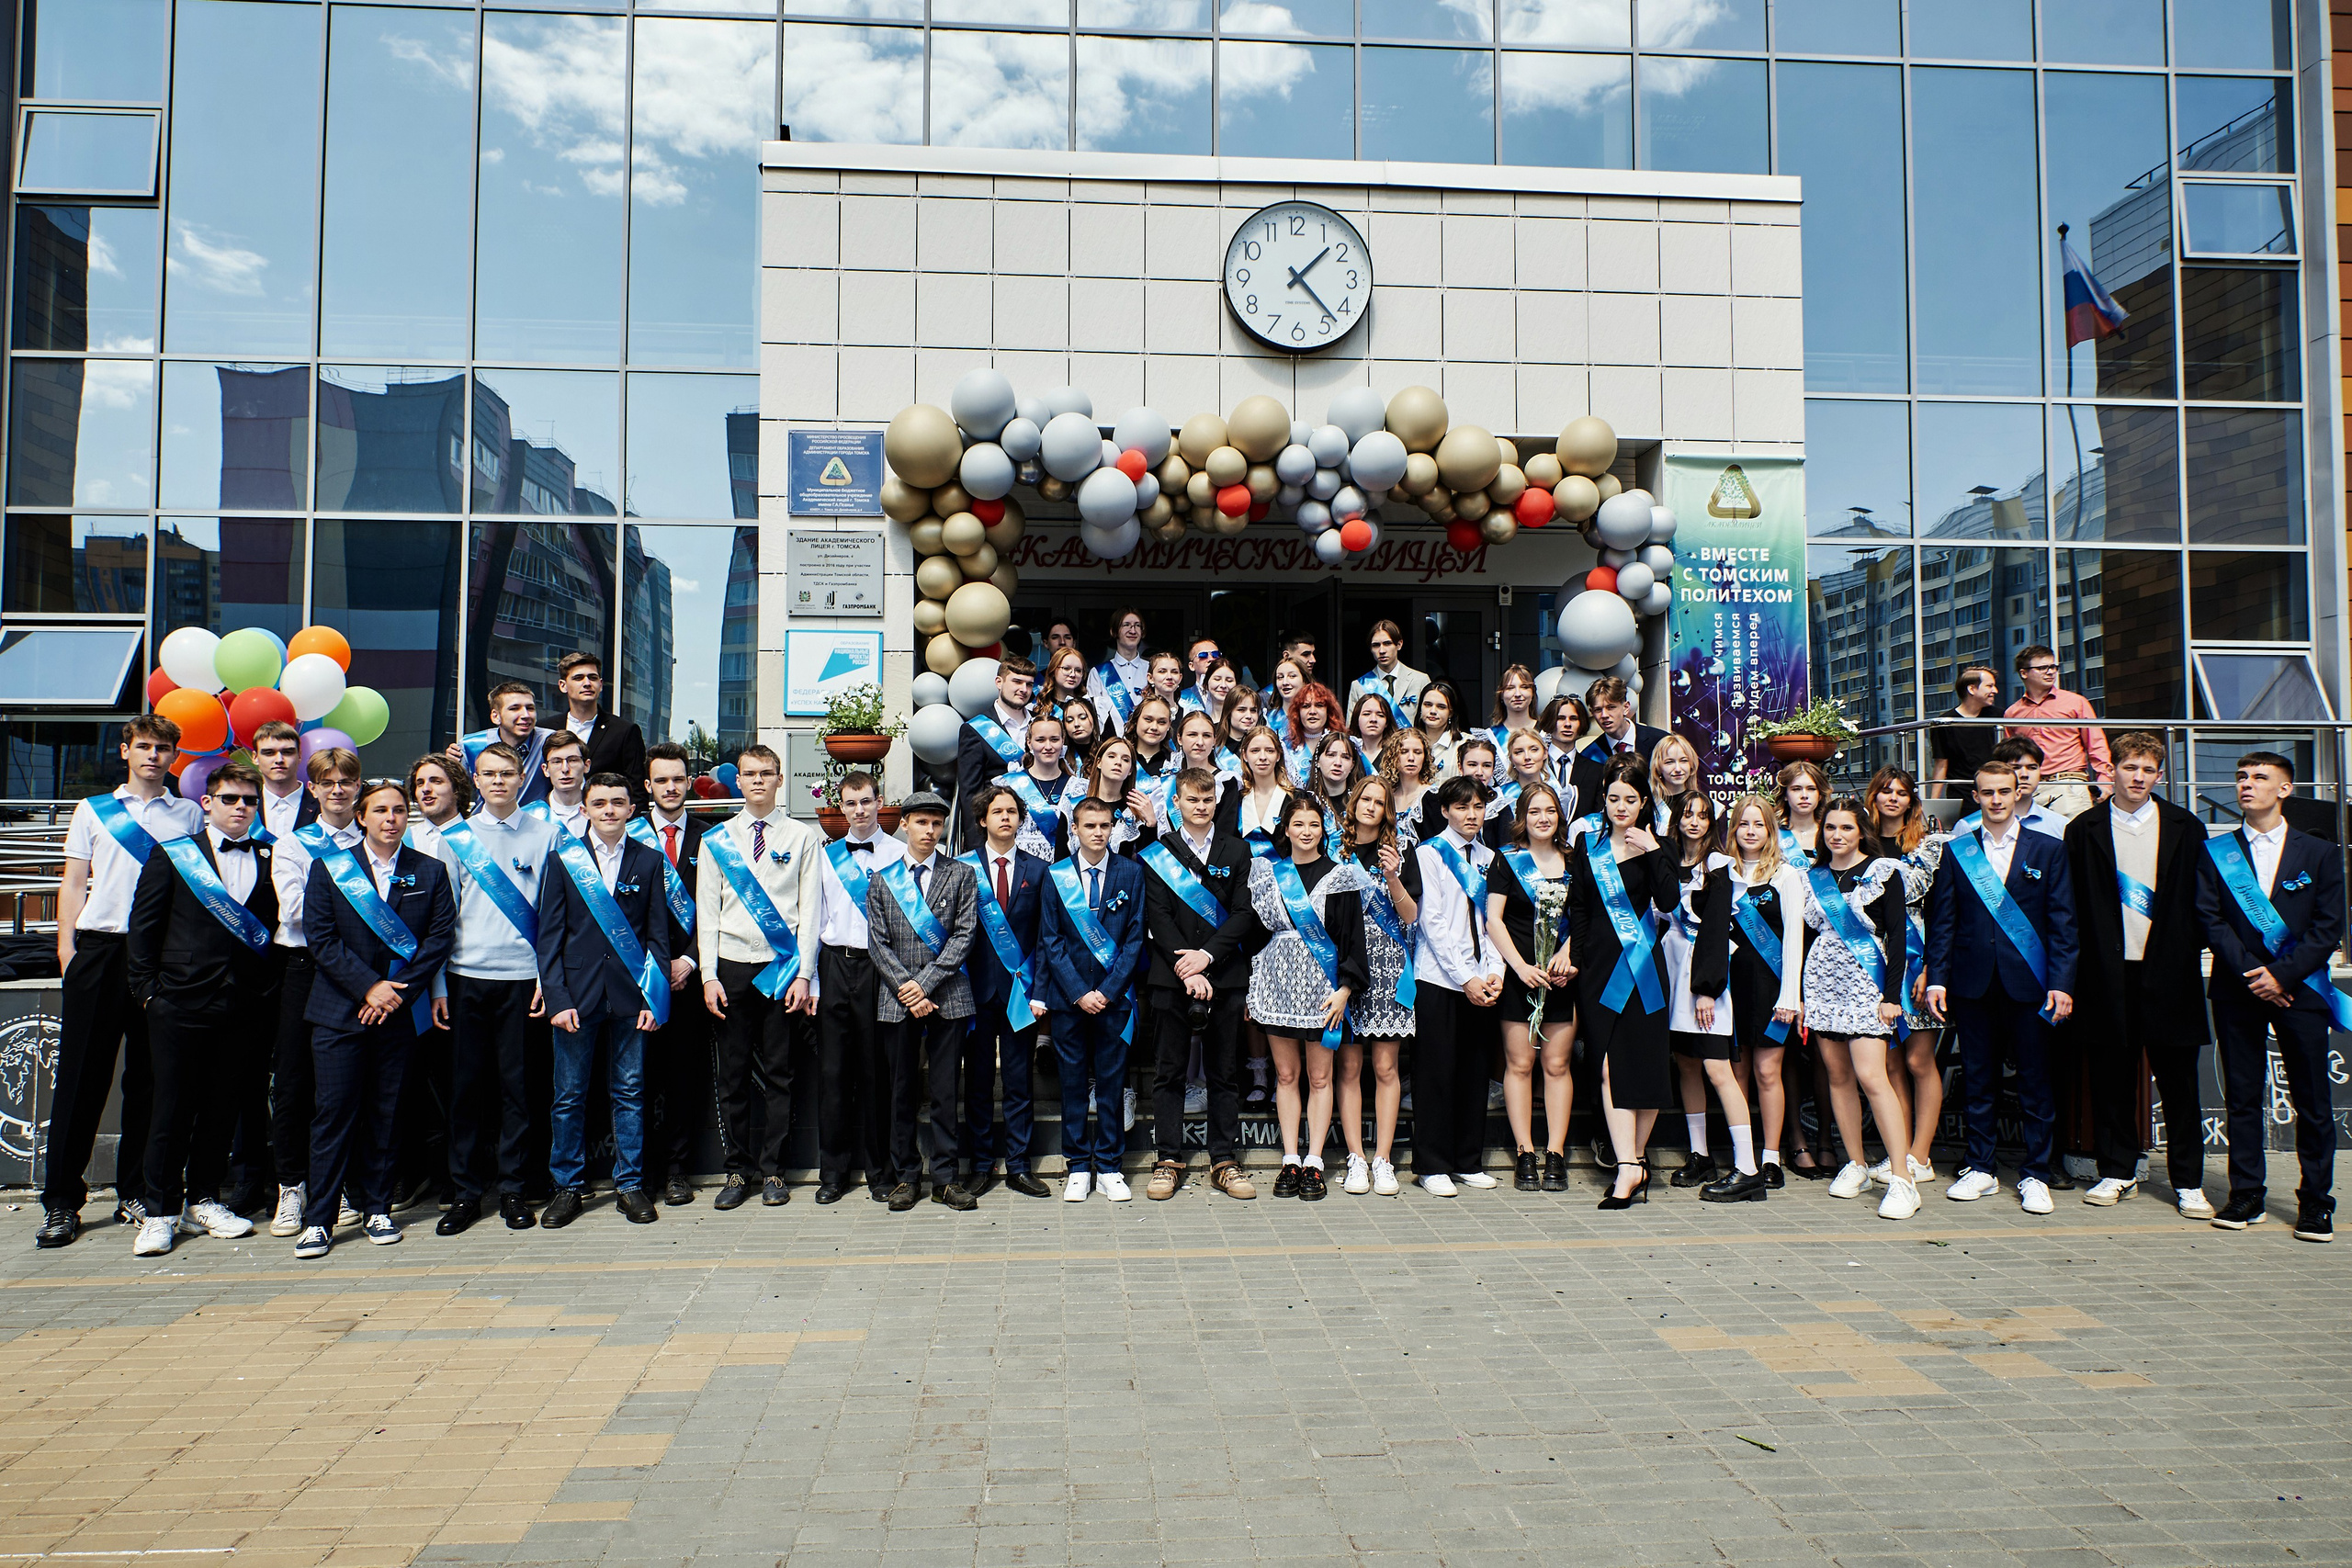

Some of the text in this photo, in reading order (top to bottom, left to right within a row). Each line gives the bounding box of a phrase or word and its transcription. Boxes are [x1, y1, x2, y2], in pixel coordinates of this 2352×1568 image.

[1264, 222, 1277, 243] 11
[1288, 216, 1306, 236] 12
[1321, 224, 1326, 243] 1
[1242, 241, 1261, 261] 10
[1336, 243, 1348, 263] 2
[1237, 268, 1250, 288] 9
[1346, 269, 1357, 289] 3
[1246, 294, 1258, 314] 8
[1337, 296, 1351, 316] 4
[1267, 315, 1282, 334] 7
[1291, 321, 1306, 342] 6
[1317, 316, 1331, 335] 5
[1701, 547, 1770, 561] ВМЕСТЕ
[1682, 568, 1789, 582] С ТОМСКИМ
[1680, 588, 1792, 603] ПОЛИТЕХОМ
[1713, 613, 1724, 667] Учимся
[1731, 613, 1741, 707] Развиваемся
[1748, 613, 1760, 709] Идем вперед
[1968, 863, 2015, 922] Выпускник
[2228, 872, 2276, 934] Выпускник
[755, 905, 784, 931] 2023
[1614, 909, 1638, 936] 2023
[611, 925, 637, 953] 2023
[198, 1214, 209, 1225] N
